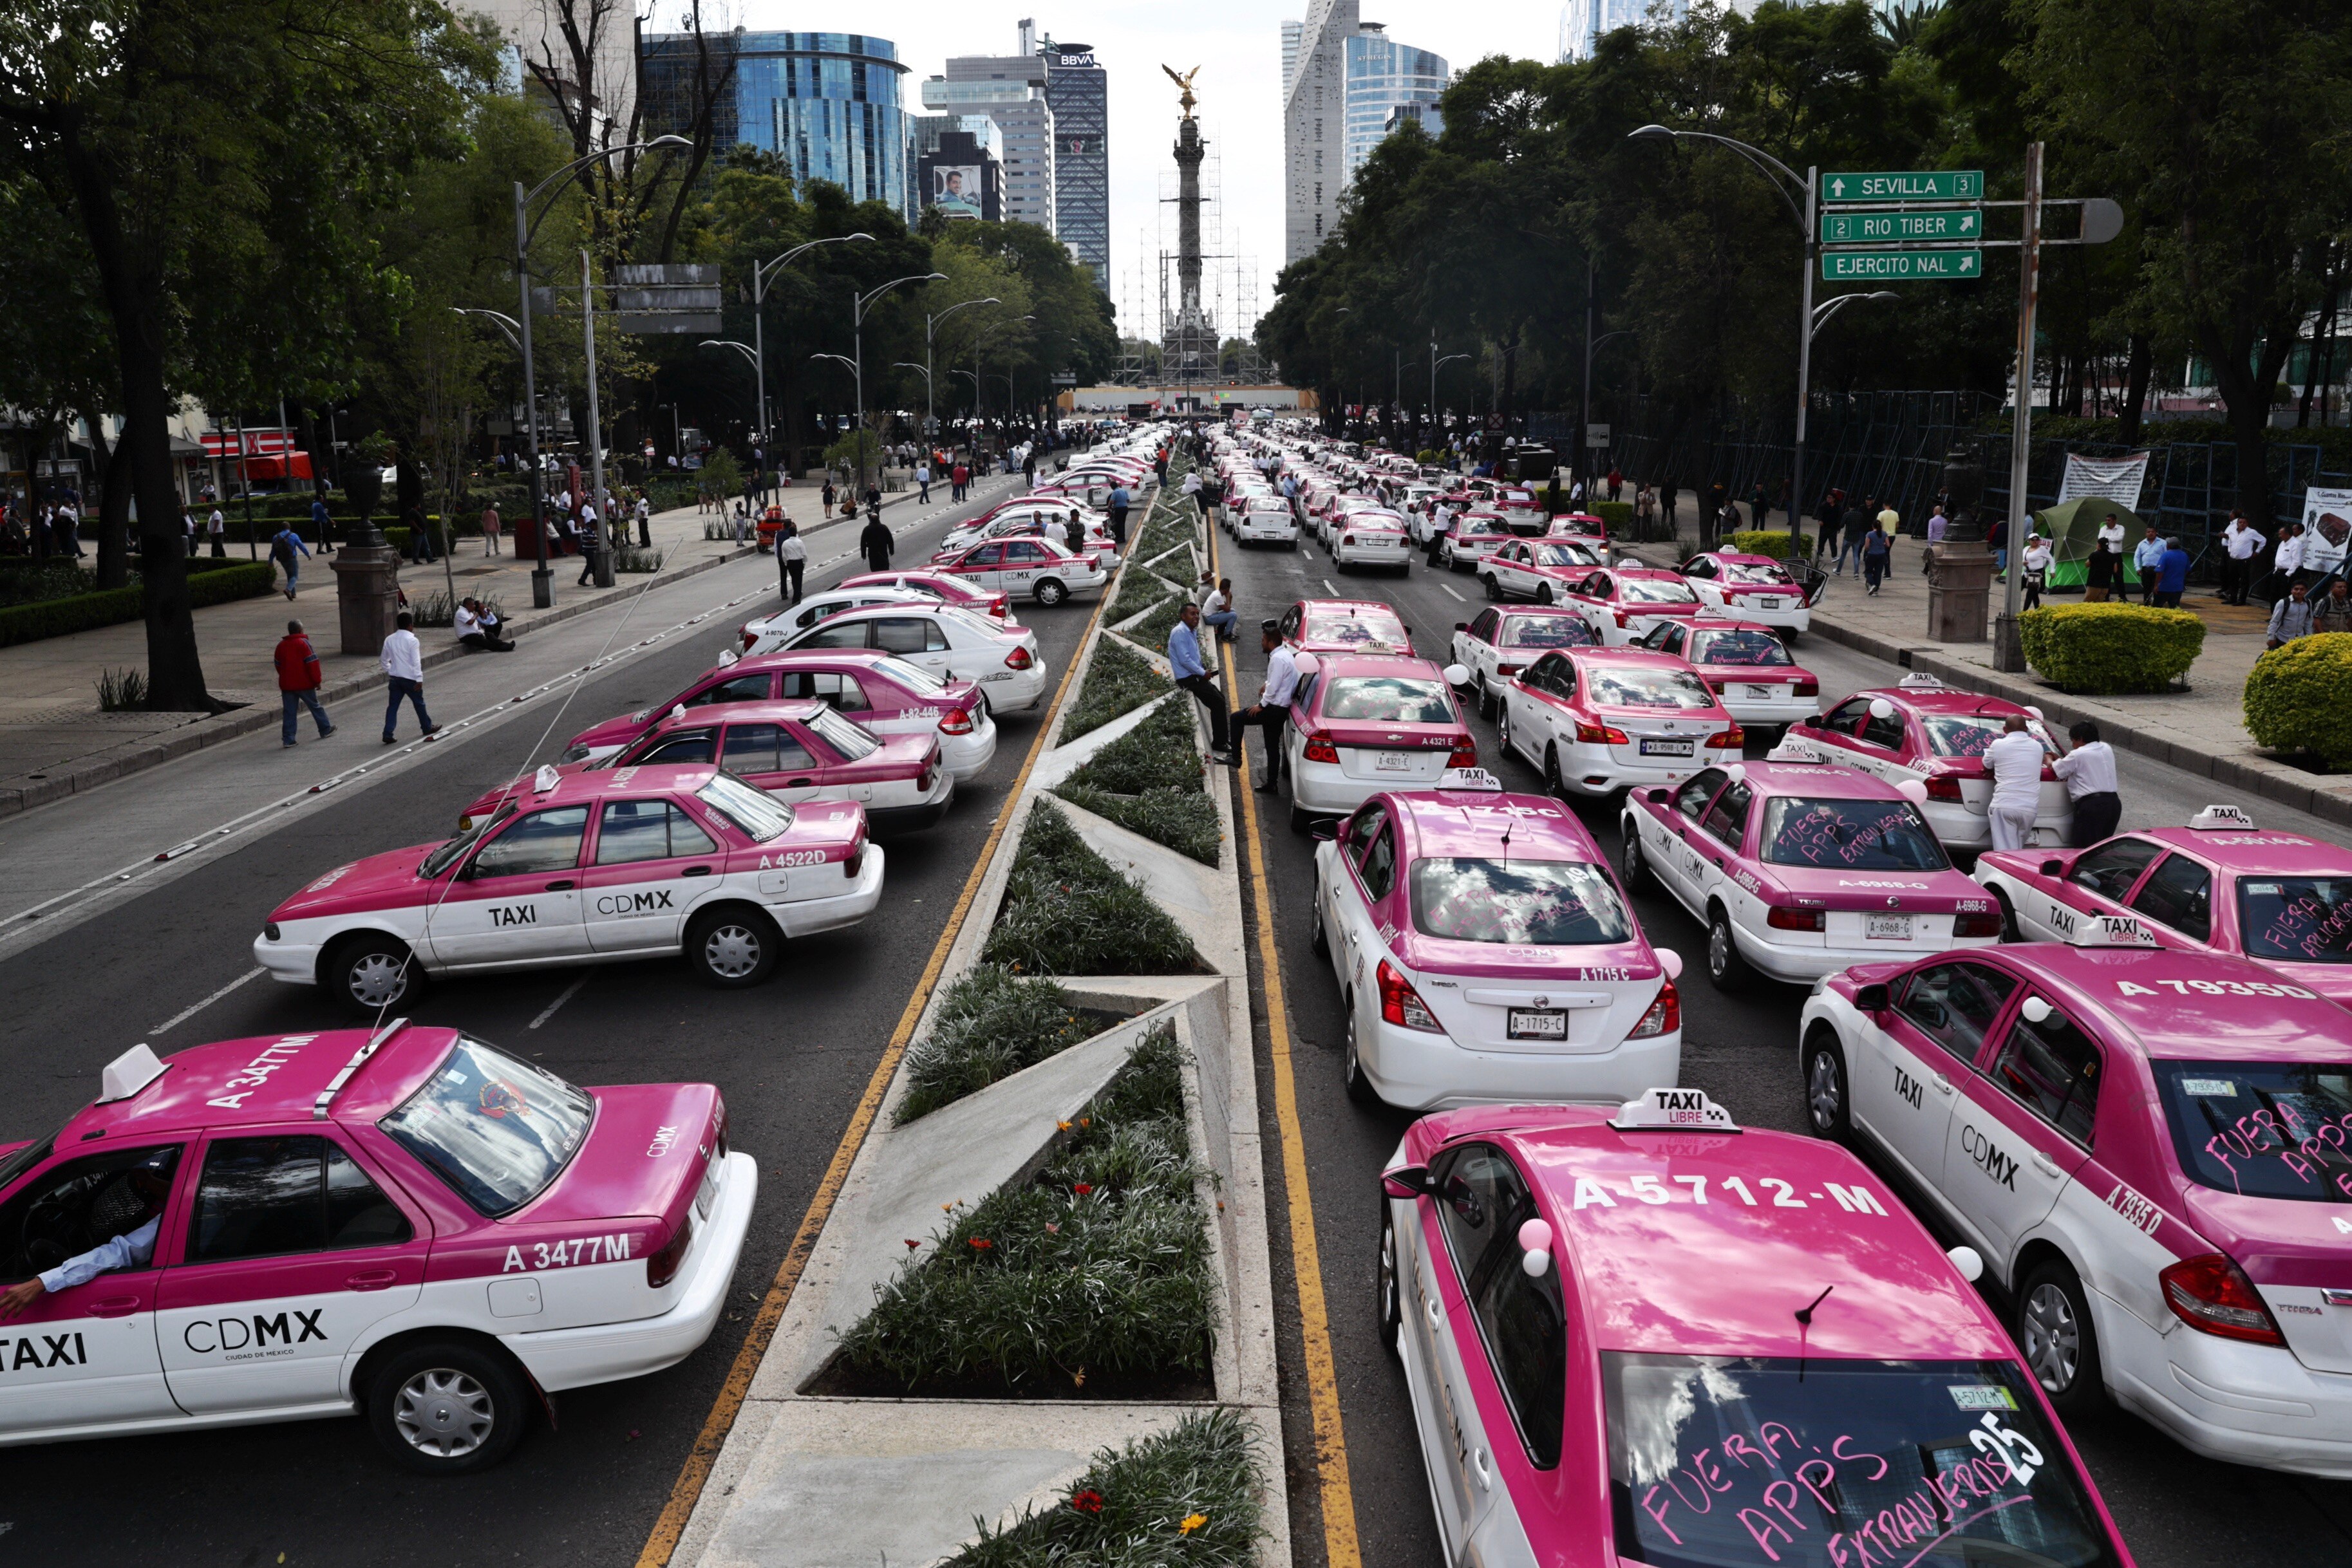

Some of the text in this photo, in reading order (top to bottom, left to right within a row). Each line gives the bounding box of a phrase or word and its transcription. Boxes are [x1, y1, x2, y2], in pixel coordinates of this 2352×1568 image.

[1062, 55, 1093, 65] BBVA
[1862, 178, 1968, 194] SEVILLA 3
[1837, 218, 1946, 235] 2 RIO TIBER
[1837, 257, 1948, 274] EJERCITO NAL
[1006, 572, 1030, 580] CDMX
[1430, 682, 1446, 693] 36
[899, 706, 939, 719] A-82-446
[1429, 737, 1445, 745] 4321
[1784, 744, 1806, 754] TAXI
[1378, 755, 1408, 766] A-4321-E
[1818, 752, 1832, 764] TAXI
[1906, 755, 1917, 768] A
[1458, 769, 1483, 780] TAXI
[1769, 767, 1852, 776] A-6968-G
[1422, 805, 1563, 818] A 1715C
[2213, 808, 2238, 819] TAXI
[1778, 807, 1835, 849] FUERA
[1655, 827, 1673, 854] CDMX
[1801, 815, 1859, 864] APPS
[759, 850, 826, 870] A 4522D
[1684, 852, 1705, 881] CDMX
[1565, 866, 1590, 885] 49
[1733, 868, 1762, 894] A-6968-G
[1839, 879, 1929, 890] A-6968-G
[597, 890, 675, 916] CDMX
[1429, 886, 1498, 928] FUERA
[1798, 898, 1825, 906] TSURU
[1955, 900, 1987, 912] A-6968-G
[489, 904, 536, 927] TAXI
[2051, 906, 2074, 935] TAXI
[2264, 897, 2320, 950] FUERA
[1870, 922, 1910, 933] A-6968-G
[2102, 918, 2137, 933] TAXI
[2109, 933, 2137, 943] LIBRE
[1506, 947, 1566, 957] CDMX
[1581, 967, 1630, 982] A 1715 C
[1424, 979, 1459, 988] VERSA
[2116, 979, 2317, 1000] A 7935D
[1512, 1016, 1562, 1031] A-1715-C
[206, 1034, 319, 1109] A 3477M
[1894, 1065, 1923, 1111] TAXI
[1655, 1092, 1702, 1110] TAXI
[1670, 1111, 1703, 1123] LIBRE
[646, 1126, 679, 1157] CDMX
[2205, 1102, 2306, 1184] FUERA
[1962, 1125, 2020, 1193] CDMX
[1573, 1175, 1890, 1217] A-5712-M
[2105, 1184, 2163, 1236] A 7935 D
[502, 1233, 630, 1273] A 3477M
[184, 1308, 328, 1353] CDMX
[225, 1352, 253, 1361] CIUDAD
[266, 1349, 294, 1357] MÉXICO
[1953, 1391, 2001, 1405] A-5712-M
[1444, 1384, 1468, 1475] CDMX
[1969, 1410, 2044, 1486] 25
[1641, 1421, 1802, 1545] FUERA
